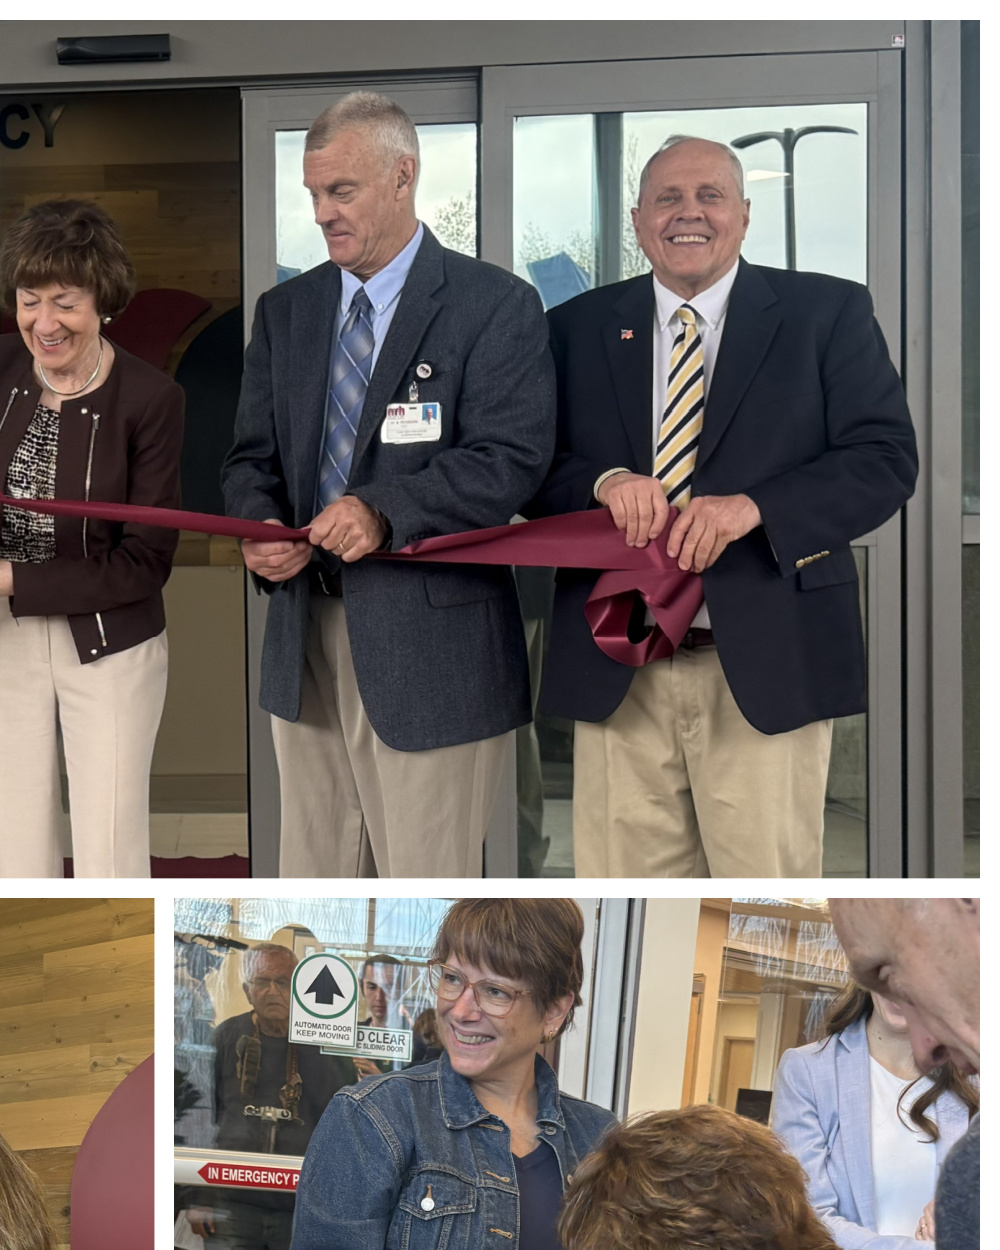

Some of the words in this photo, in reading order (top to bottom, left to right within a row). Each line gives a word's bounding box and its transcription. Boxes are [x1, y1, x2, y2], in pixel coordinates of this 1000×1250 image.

[294, 1021, 332, 1031] AUTOMATIC
[332, 1025, 352, 1033] DOOR
[296, 1029, 317, 1038] KEEP
[318, 1032, 350, 1041] MOVING
[367, 1031, 406, 1046] CLEAR
[363, 1043, 386, 1051] SLIDING
[208, 1167, 219, 1179] IN
[221, 1168, 290, 1185] EMERGENCY
